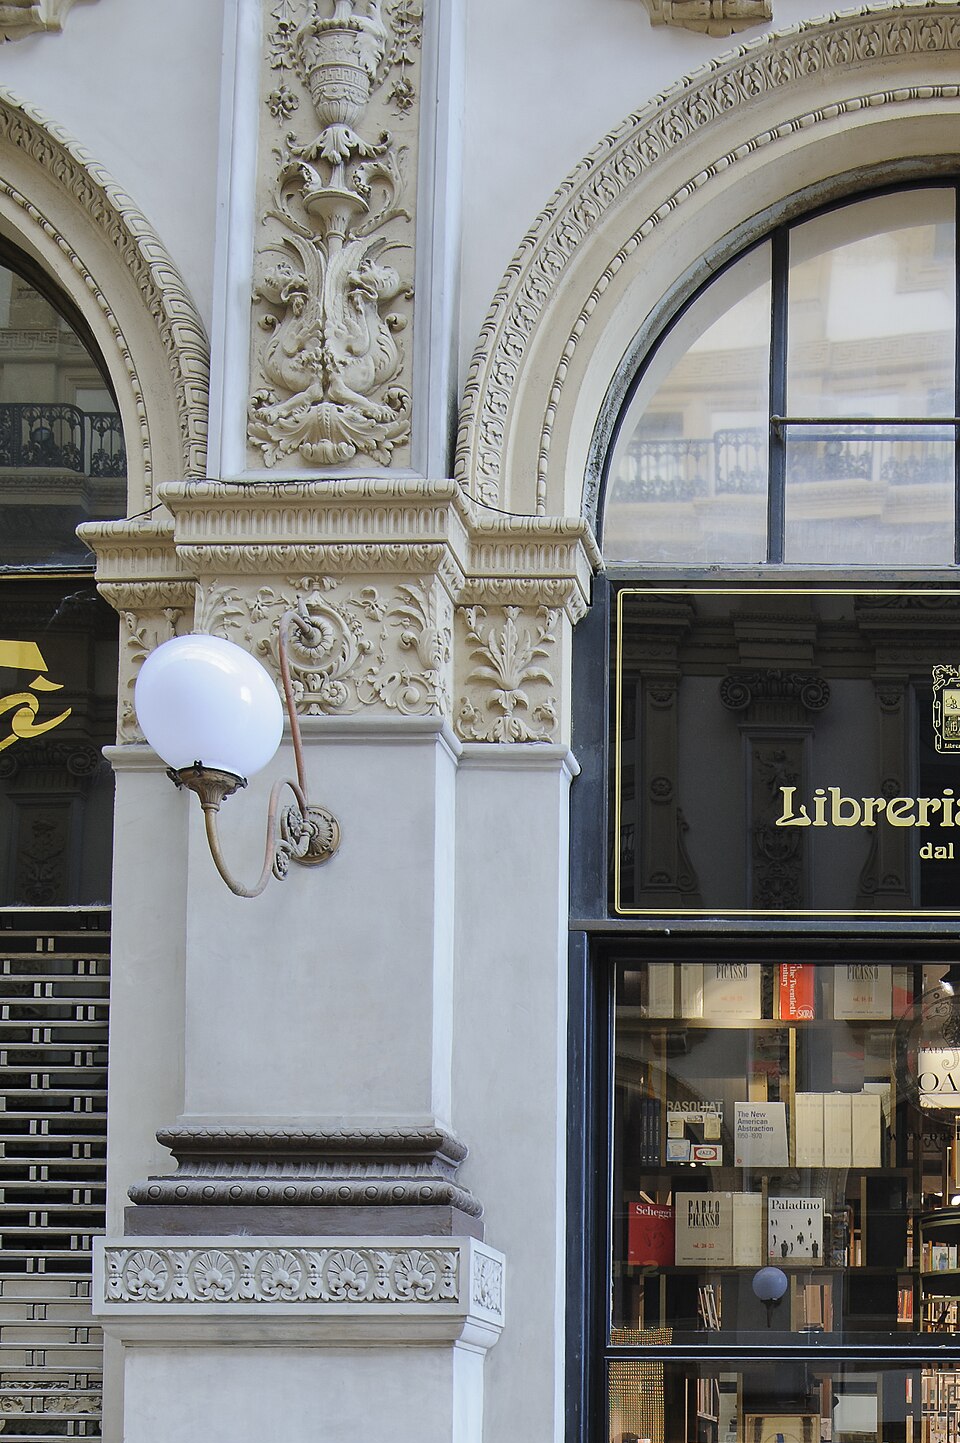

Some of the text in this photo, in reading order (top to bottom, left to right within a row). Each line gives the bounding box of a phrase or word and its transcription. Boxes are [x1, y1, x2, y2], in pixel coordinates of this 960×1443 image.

[919, 843, 954, 860] dal
[716, 964, 748, 979] PICASSO
[781, 963, 789, 987] entury
[847, 964, 879, 979] PICASSO
[789, 979, 797, 1015] Twentieth
[667, 1101, 723, 1112] BASQUIAT
[688, 1200, 720, 1213] PABLO
[771, 1199, 820, 1210] Paladino
[635, 1205, 672, 1219] Scheggi
[688, 1213, 720, 1226] PICASSO
